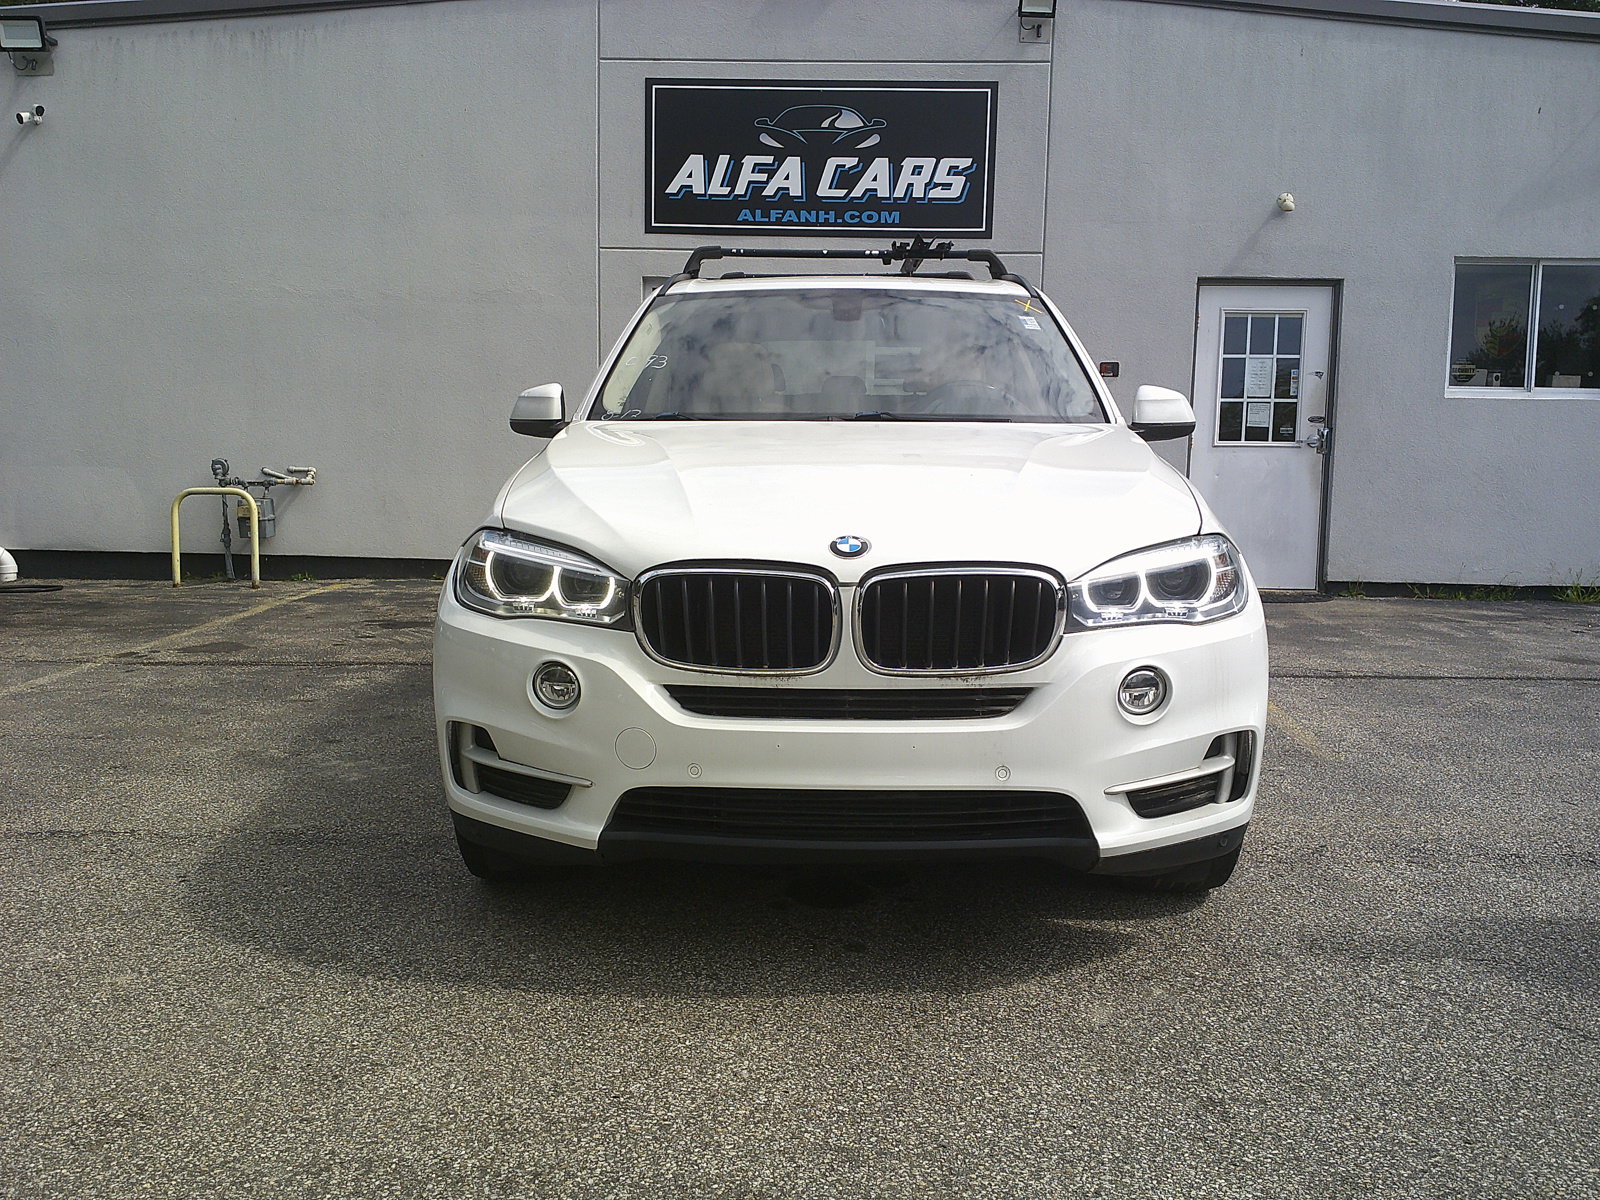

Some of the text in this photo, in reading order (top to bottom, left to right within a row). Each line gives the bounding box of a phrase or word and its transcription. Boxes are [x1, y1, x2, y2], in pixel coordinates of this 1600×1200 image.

[665, 154, 976, 203] ALFA CARS
[737, 208, 900, 224] ALFANH.COM
